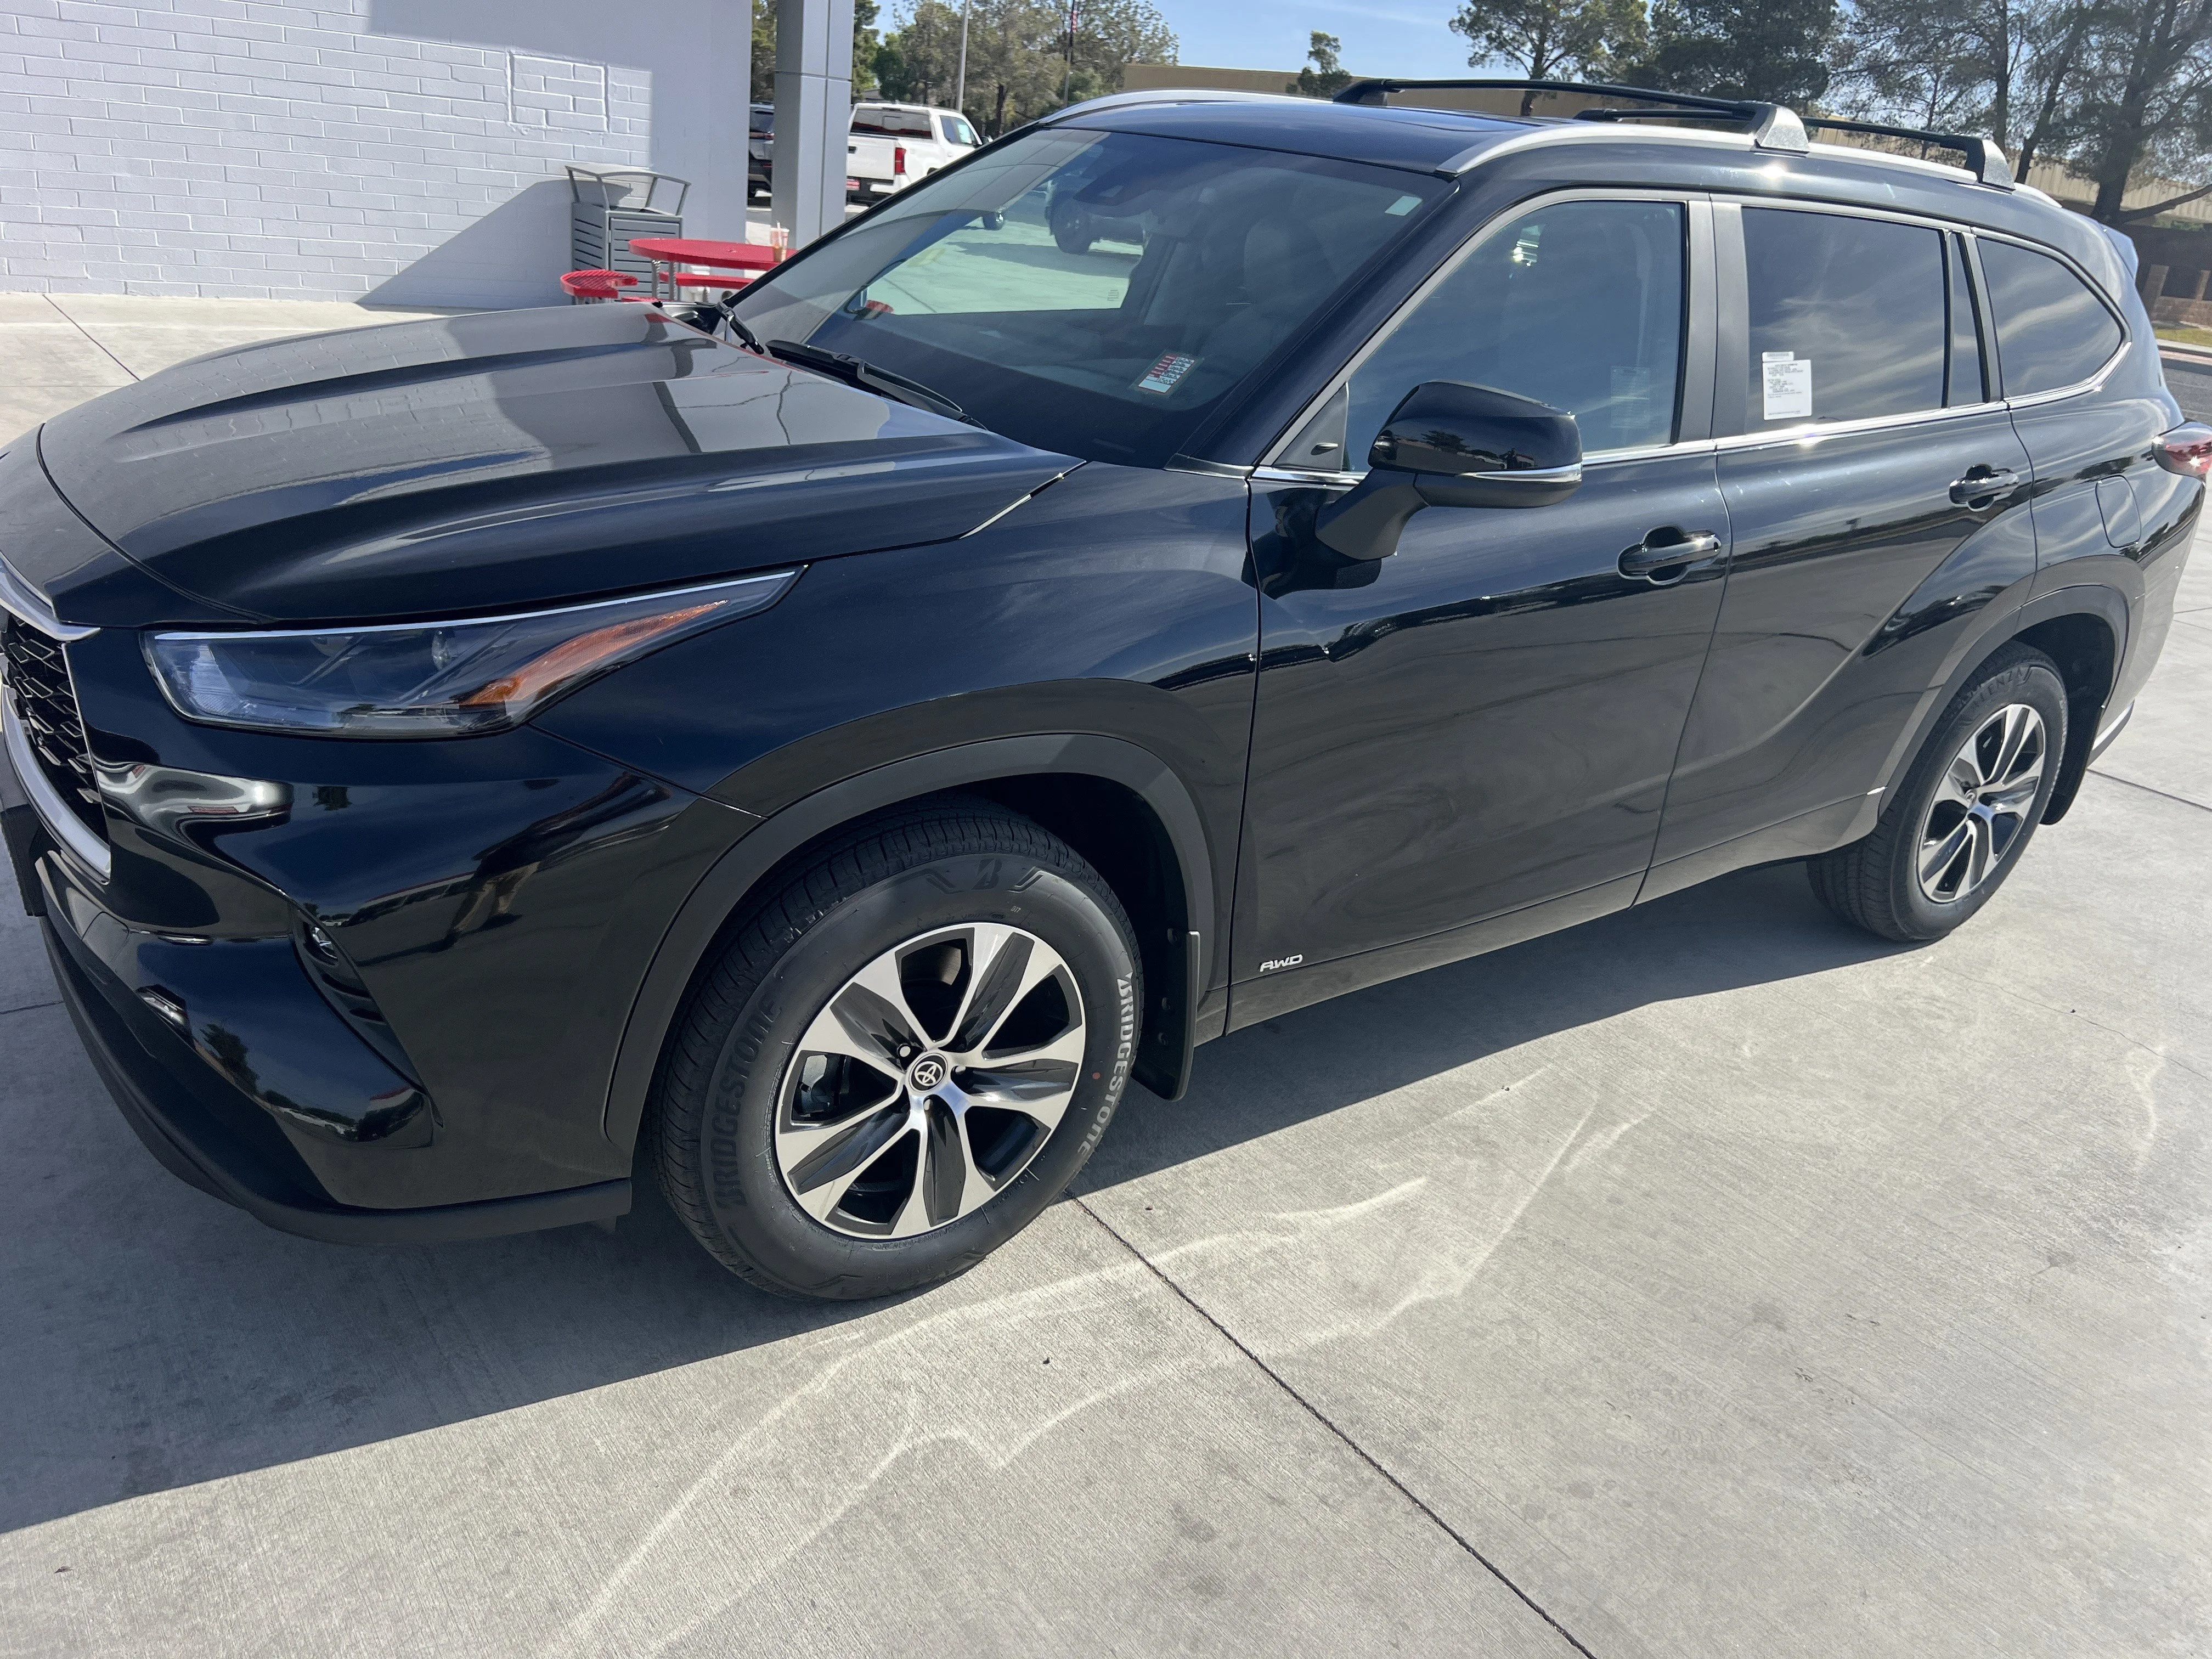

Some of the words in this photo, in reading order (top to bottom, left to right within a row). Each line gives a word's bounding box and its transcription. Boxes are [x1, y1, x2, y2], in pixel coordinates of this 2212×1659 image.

[1259, 954, 1303, 972] AWD
[710, 994, 783, 1206] BRIDGESTONE
[1077, 971, 1134, 1155] BRIDGESTONE
